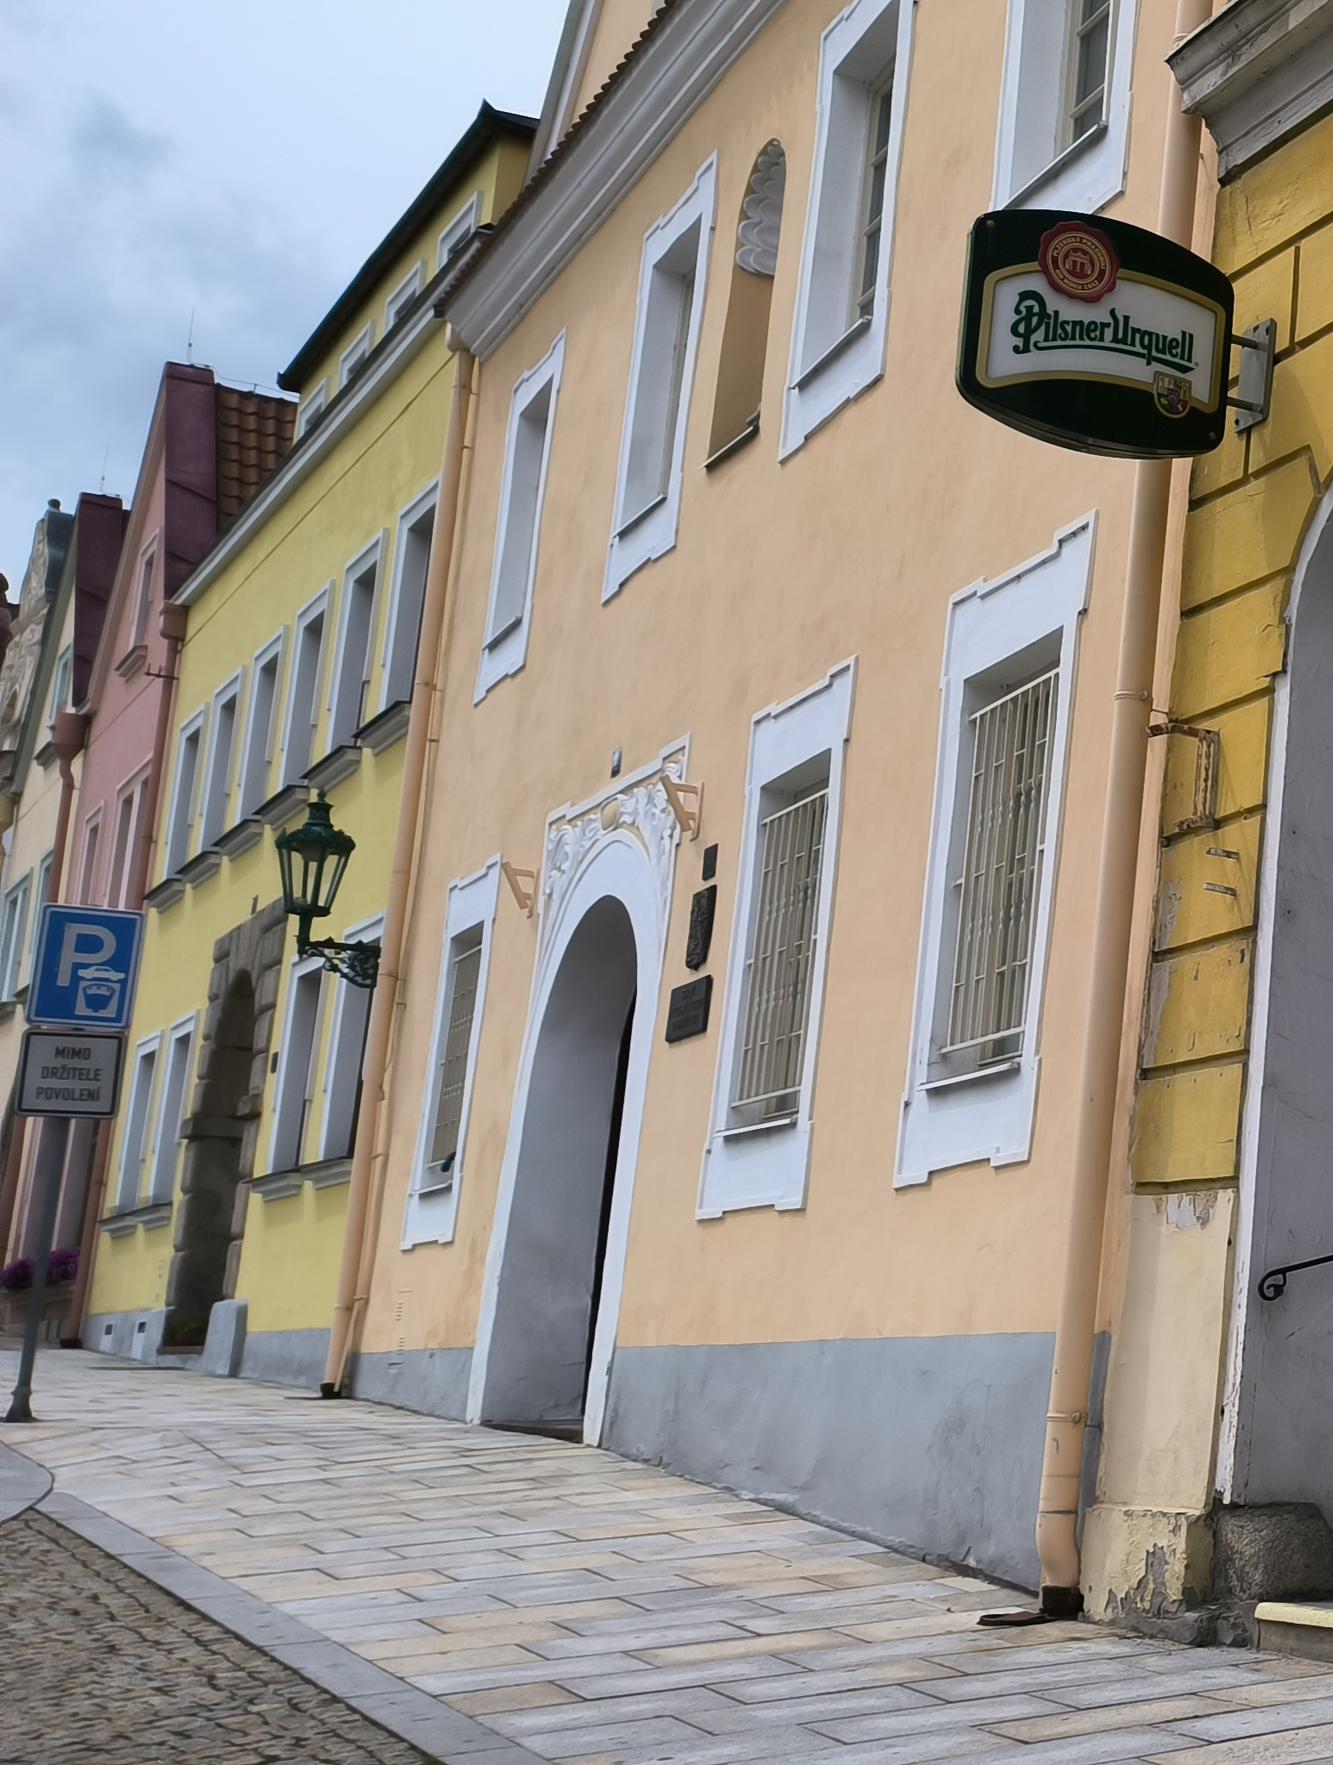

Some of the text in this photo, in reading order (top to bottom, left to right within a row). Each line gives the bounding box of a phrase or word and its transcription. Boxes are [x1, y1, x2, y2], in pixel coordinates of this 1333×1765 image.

[1010, 289, 1194, 366] Pilsner Urquell
[56, 922, 118, 987] P
[54, 1046, 92, 1061] MIMO
[40, 1065, 102, 1082] DRŽITELE
[35, 1084, 101, 1102] POVOLENÍ
